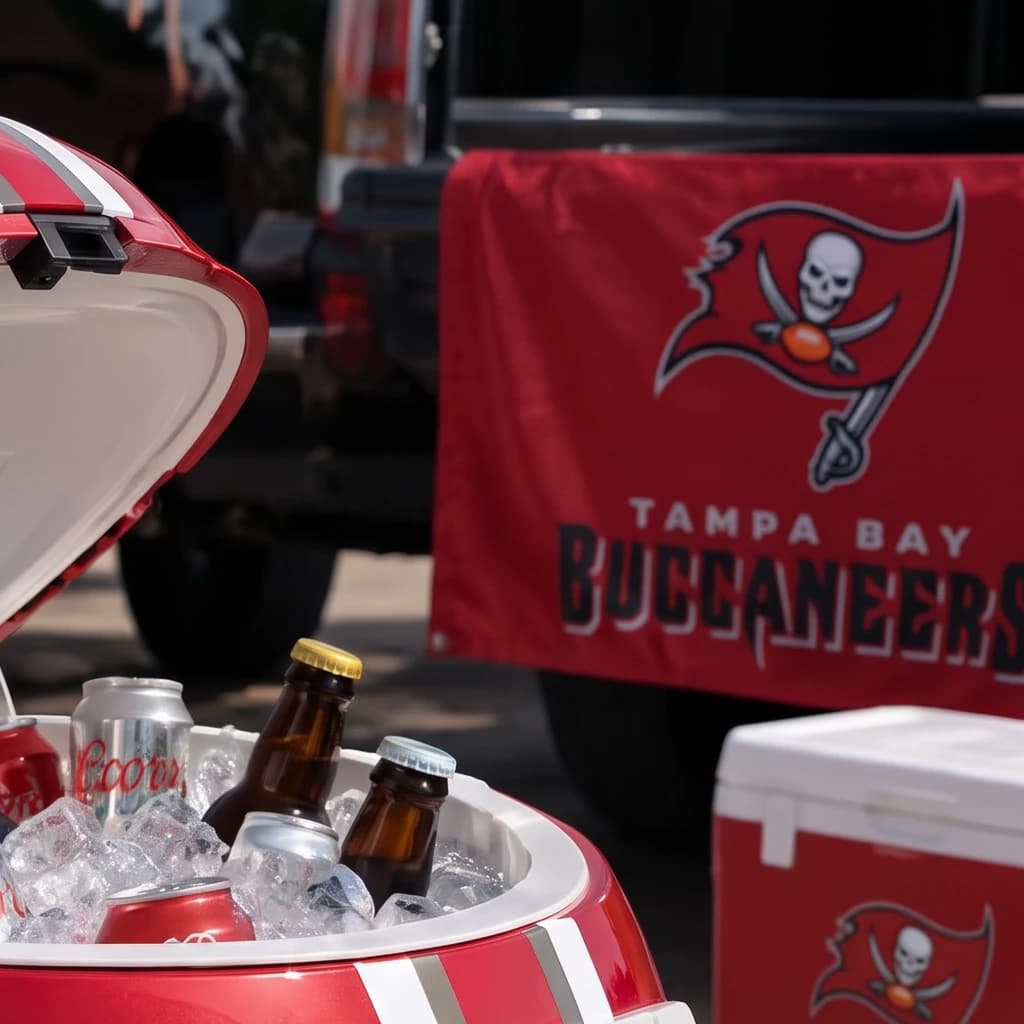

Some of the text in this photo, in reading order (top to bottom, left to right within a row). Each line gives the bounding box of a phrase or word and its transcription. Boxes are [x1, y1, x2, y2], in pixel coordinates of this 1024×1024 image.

[628, 497, 971, 559] TAMPA BAY
[555, 521, 1024, 684] BUCCANEERS
